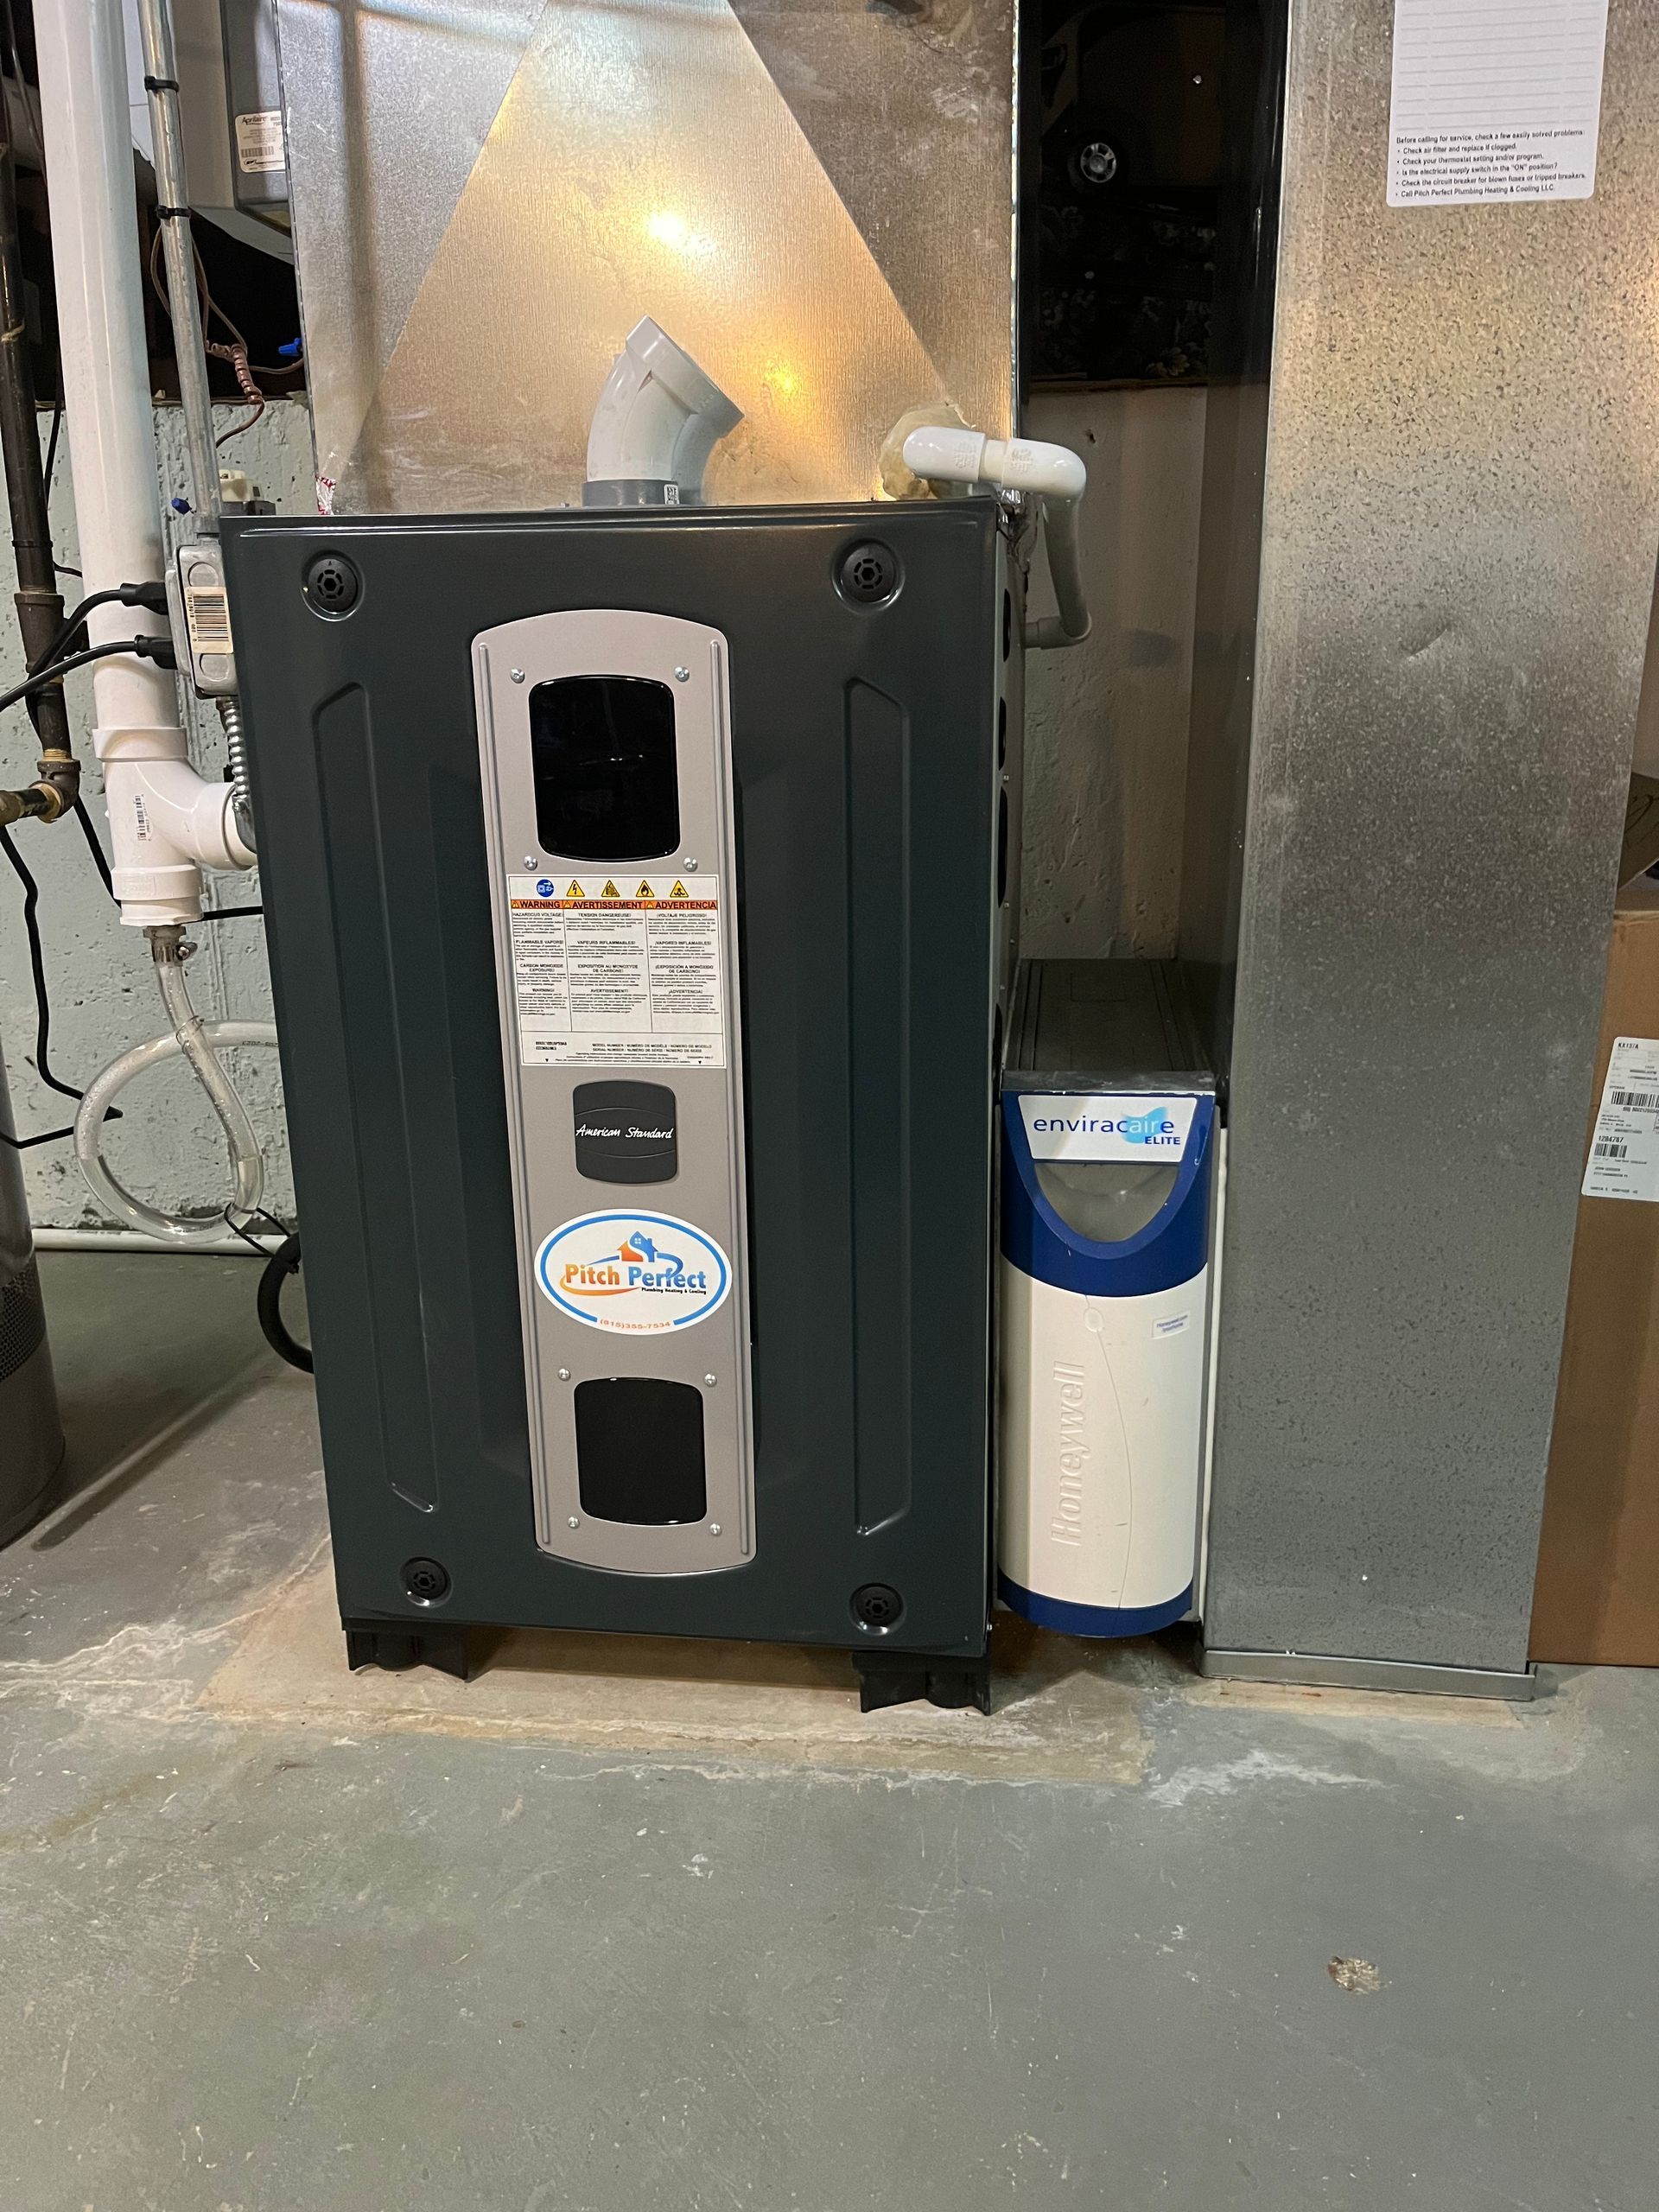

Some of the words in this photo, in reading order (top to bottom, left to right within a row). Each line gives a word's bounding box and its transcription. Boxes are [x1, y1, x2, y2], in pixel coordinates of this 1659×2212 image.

[575, 1123, 620, 1137] American
[625, 1127, 674, 1139] Standard
[1033, 1115, 1174, 1134] enviracaire
[1144, 1136, 1180, 1145] ELITE
[565, 1263, 620, 1285] Pitch
[628, 1268, 707, 1288] Perfect
[1050, 1361, 1090, 1547] Honeywell
